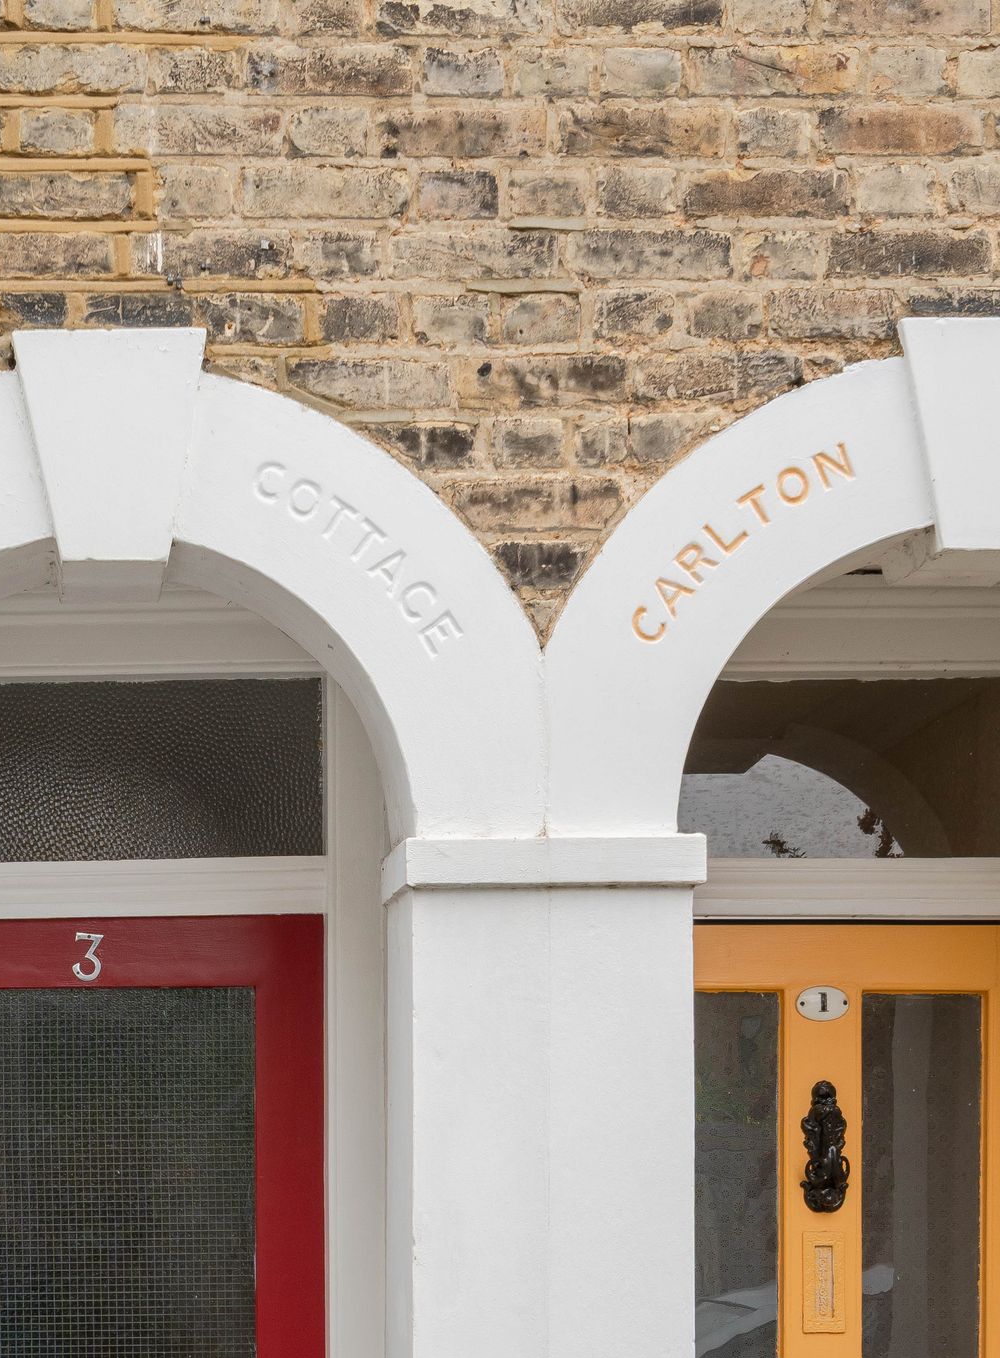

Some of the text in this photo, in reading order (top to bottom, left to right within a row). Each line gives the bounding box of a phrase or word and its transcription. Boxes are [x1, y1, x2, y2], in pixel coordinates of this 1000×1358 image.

[631, 441, 856, 643] CARLTON
[71, 931, 104, 981] 3
[817, 991, 829, 1012] 1
